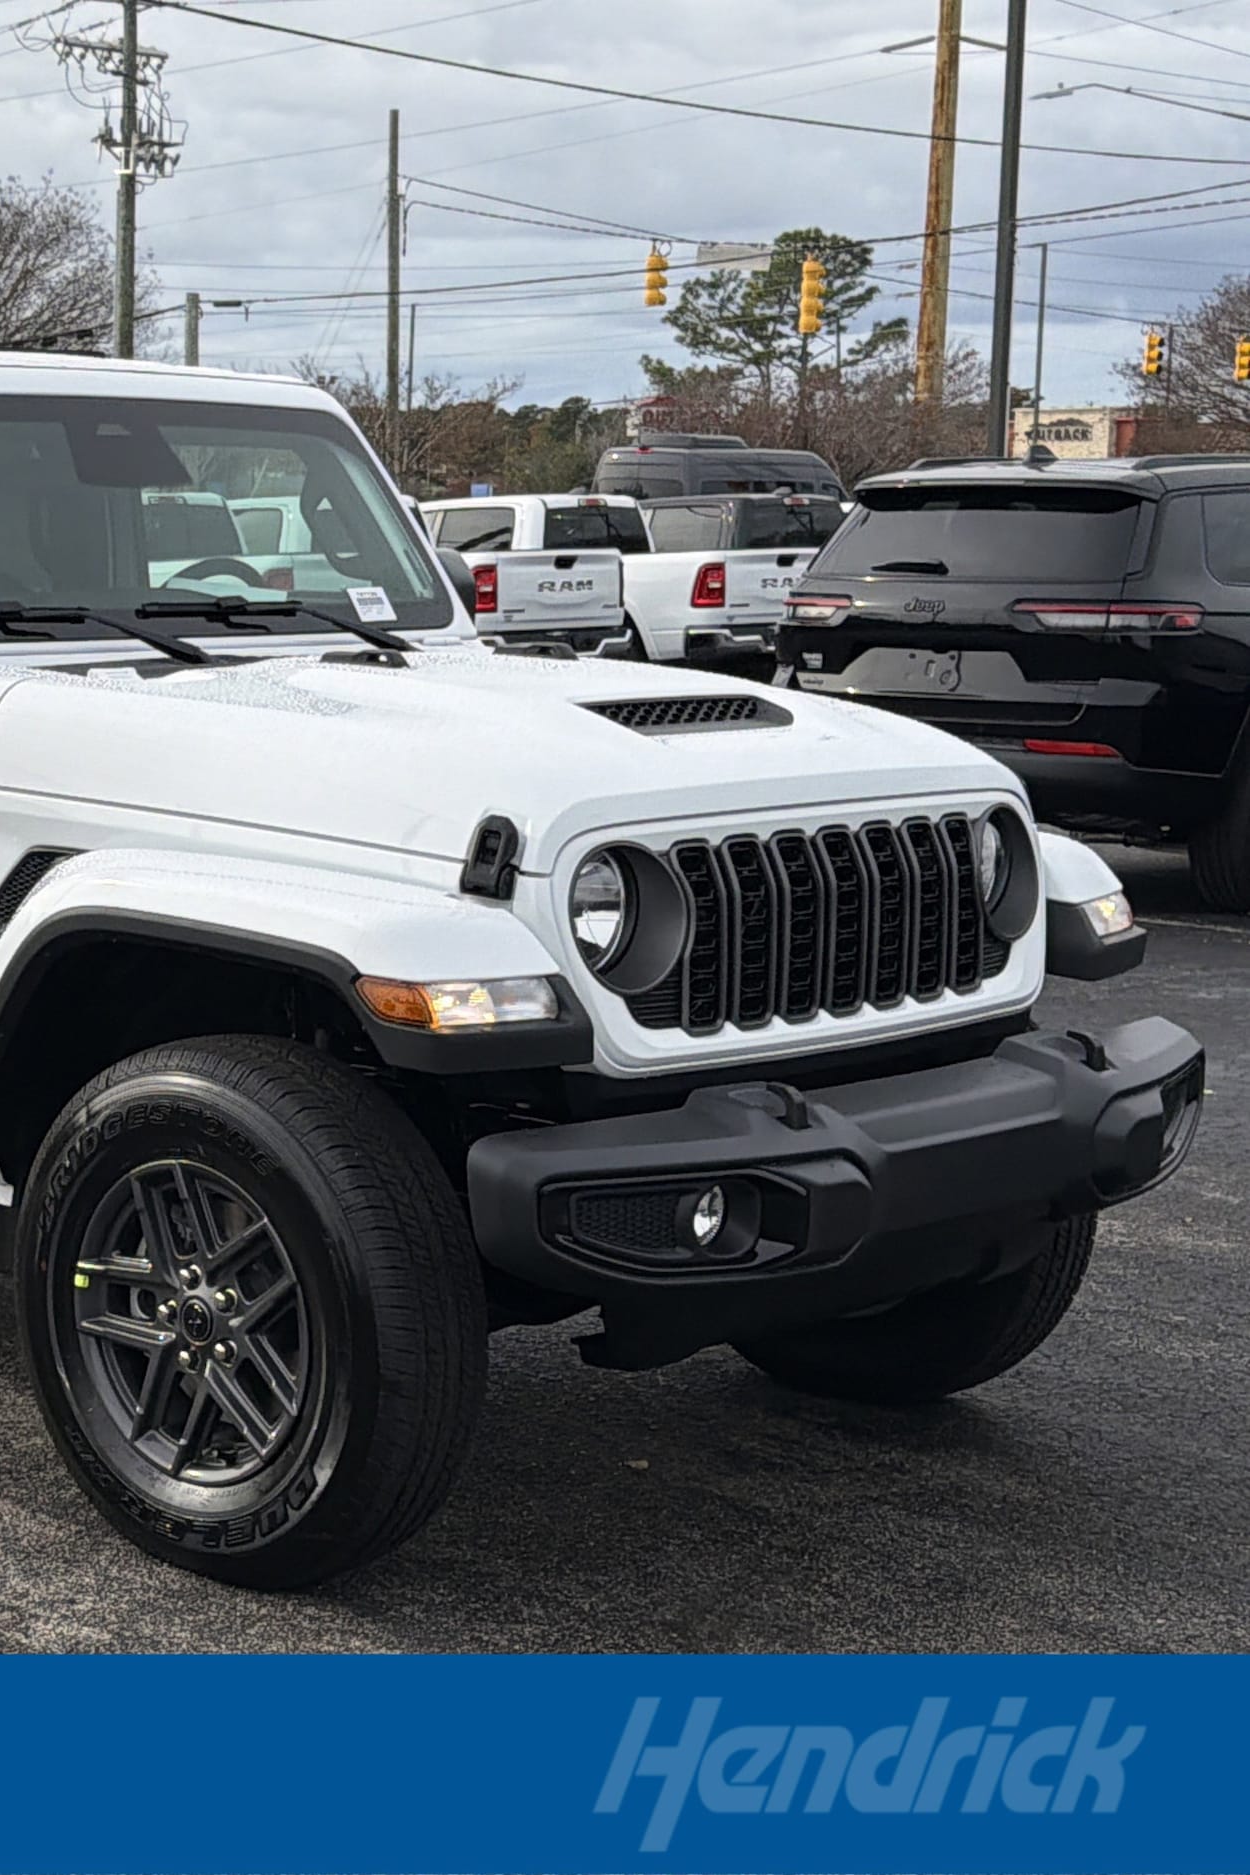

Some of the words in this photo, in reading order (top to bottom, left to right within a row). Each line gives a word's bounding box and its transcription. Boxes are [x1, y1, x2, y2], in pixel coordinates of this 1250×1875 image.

[537, 579, 594, 593] RAM
[760, 577, 801, 589] RA
[903, 596, 946, 620] Jeep
[38, 1101, 280, 1232] BRIDGESTONE
[117, 1461, 318, 1548] DUELER
